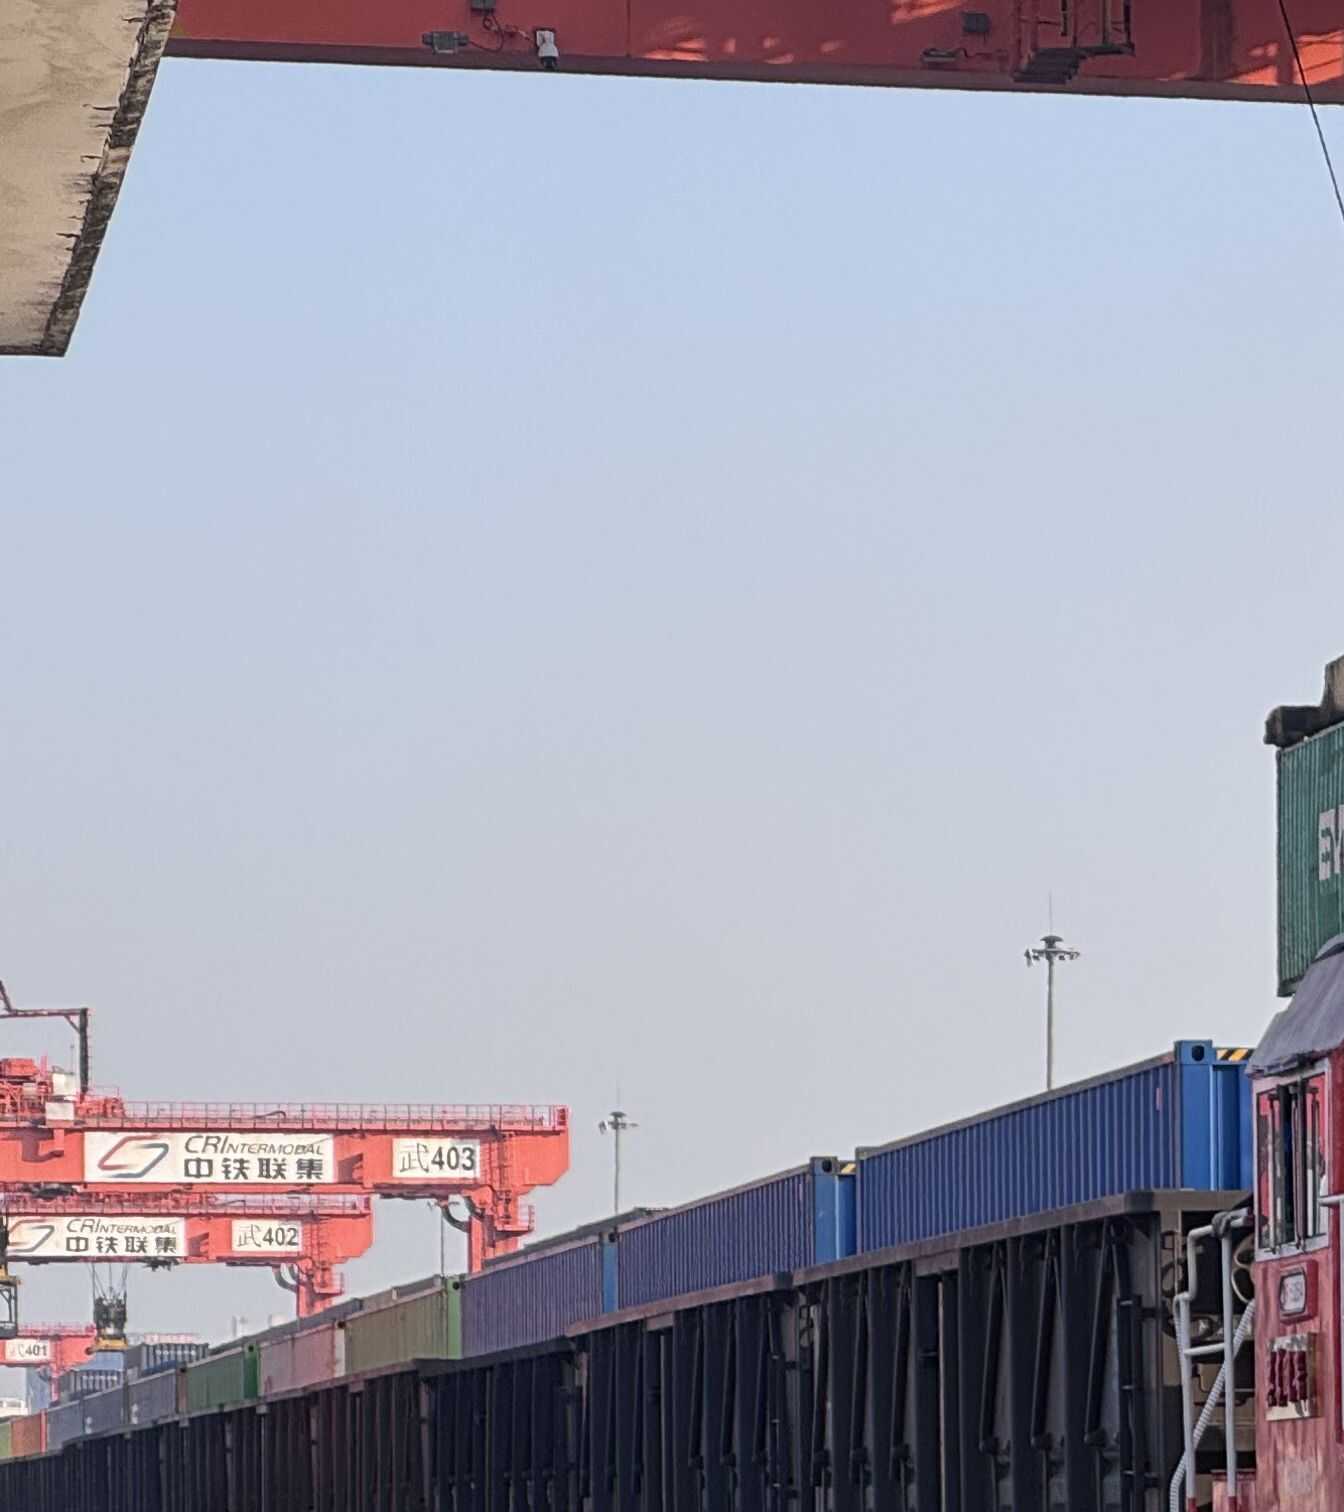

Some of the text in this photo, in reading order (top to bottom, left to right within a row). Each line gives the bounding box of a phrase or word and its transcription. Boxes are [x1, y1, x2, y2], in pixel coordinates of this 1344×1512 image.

[184, 1157, 324, 1180] 中铁联集
[66, 1235, 177, 1254] 中铁联集
